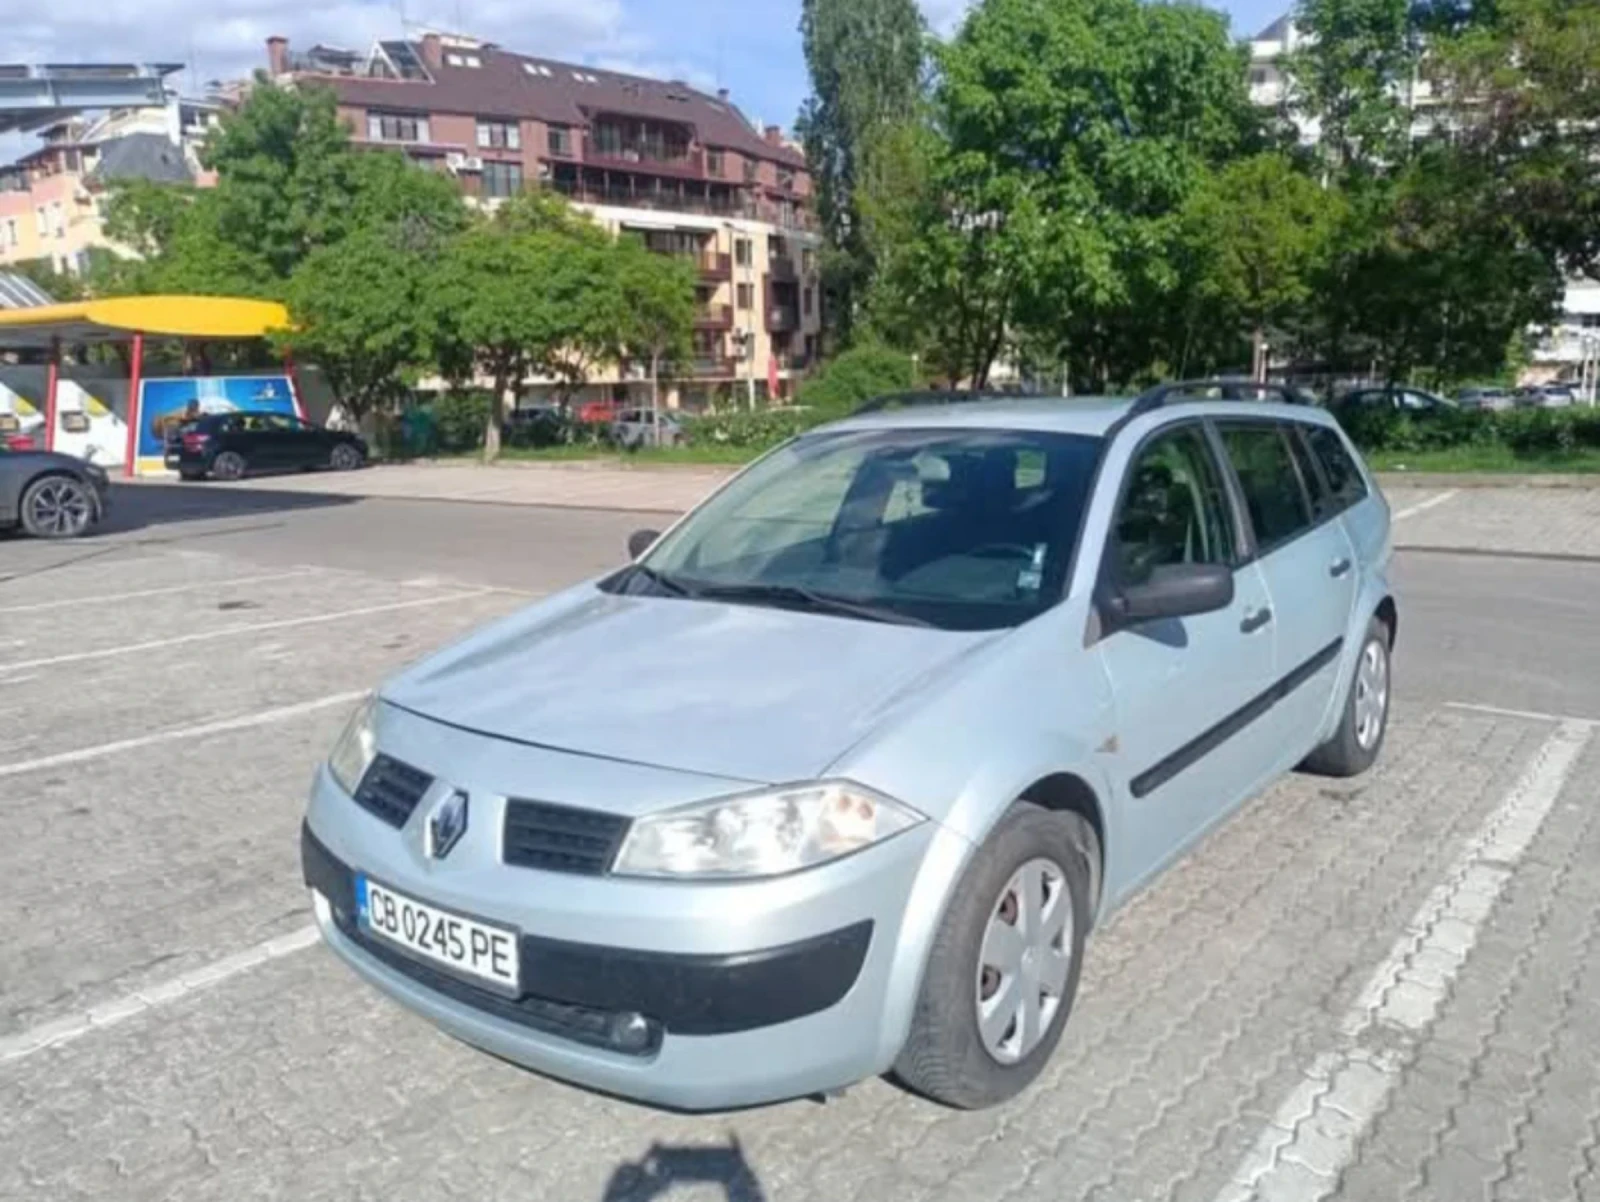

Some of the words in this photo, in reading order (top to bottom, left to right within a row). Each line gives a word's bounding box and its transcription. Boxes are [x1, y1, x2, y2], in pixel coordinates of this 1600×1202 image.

[371, 889, 398, 933] CB
[402, 904, 465, 960] 0245
[470, 927, 511, 978] PE
